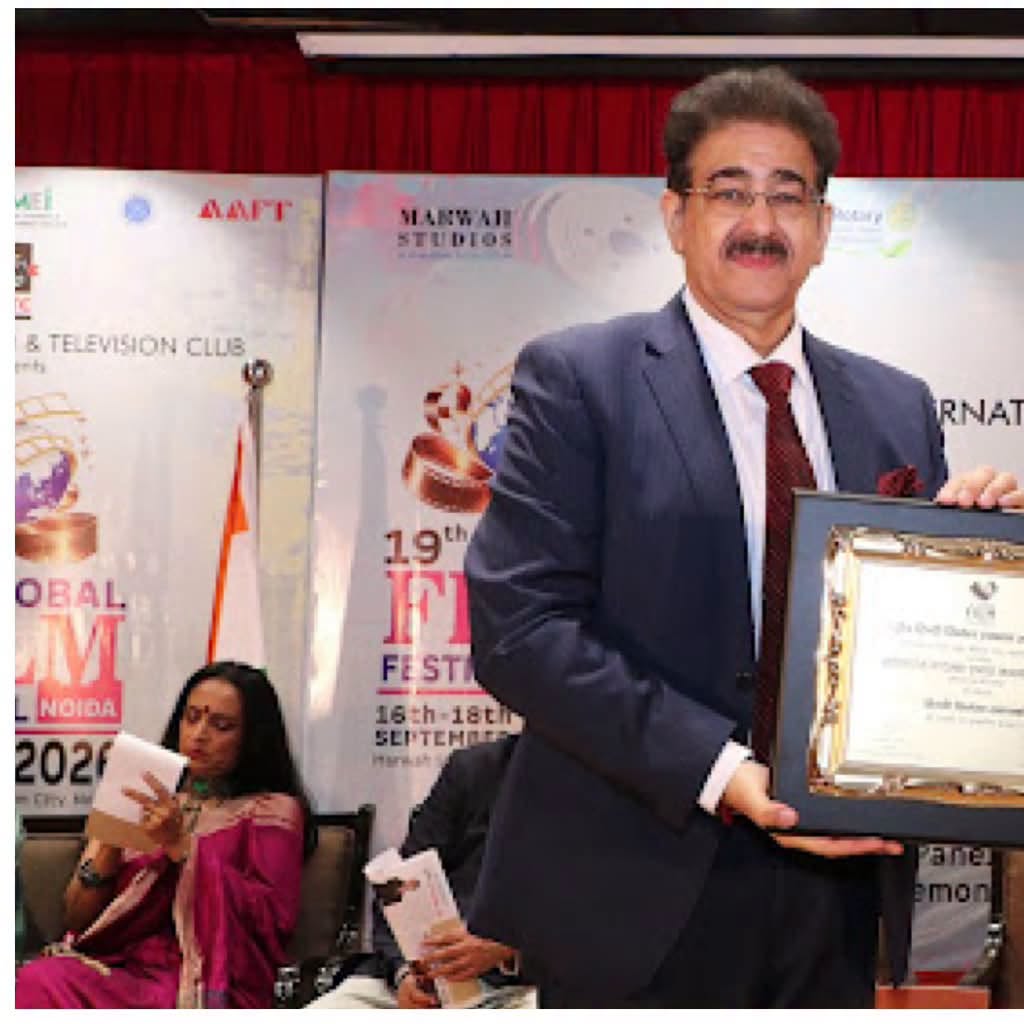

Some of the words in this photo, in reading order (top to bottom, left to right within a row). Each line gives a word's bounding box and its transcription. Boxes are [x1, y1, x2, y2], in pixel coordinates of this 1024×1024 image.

[199, 198, 293, 222] AAFT
[398, 230, 513, 248] STUDIOS
[26, 333, 41, 354] &
[48, 333, 177, 356] TELEVISION
[186, 337, 247, 358] CLUB
[384, 527, 469, 565] 19th
[40, 697, 117, 718] NOIDA
